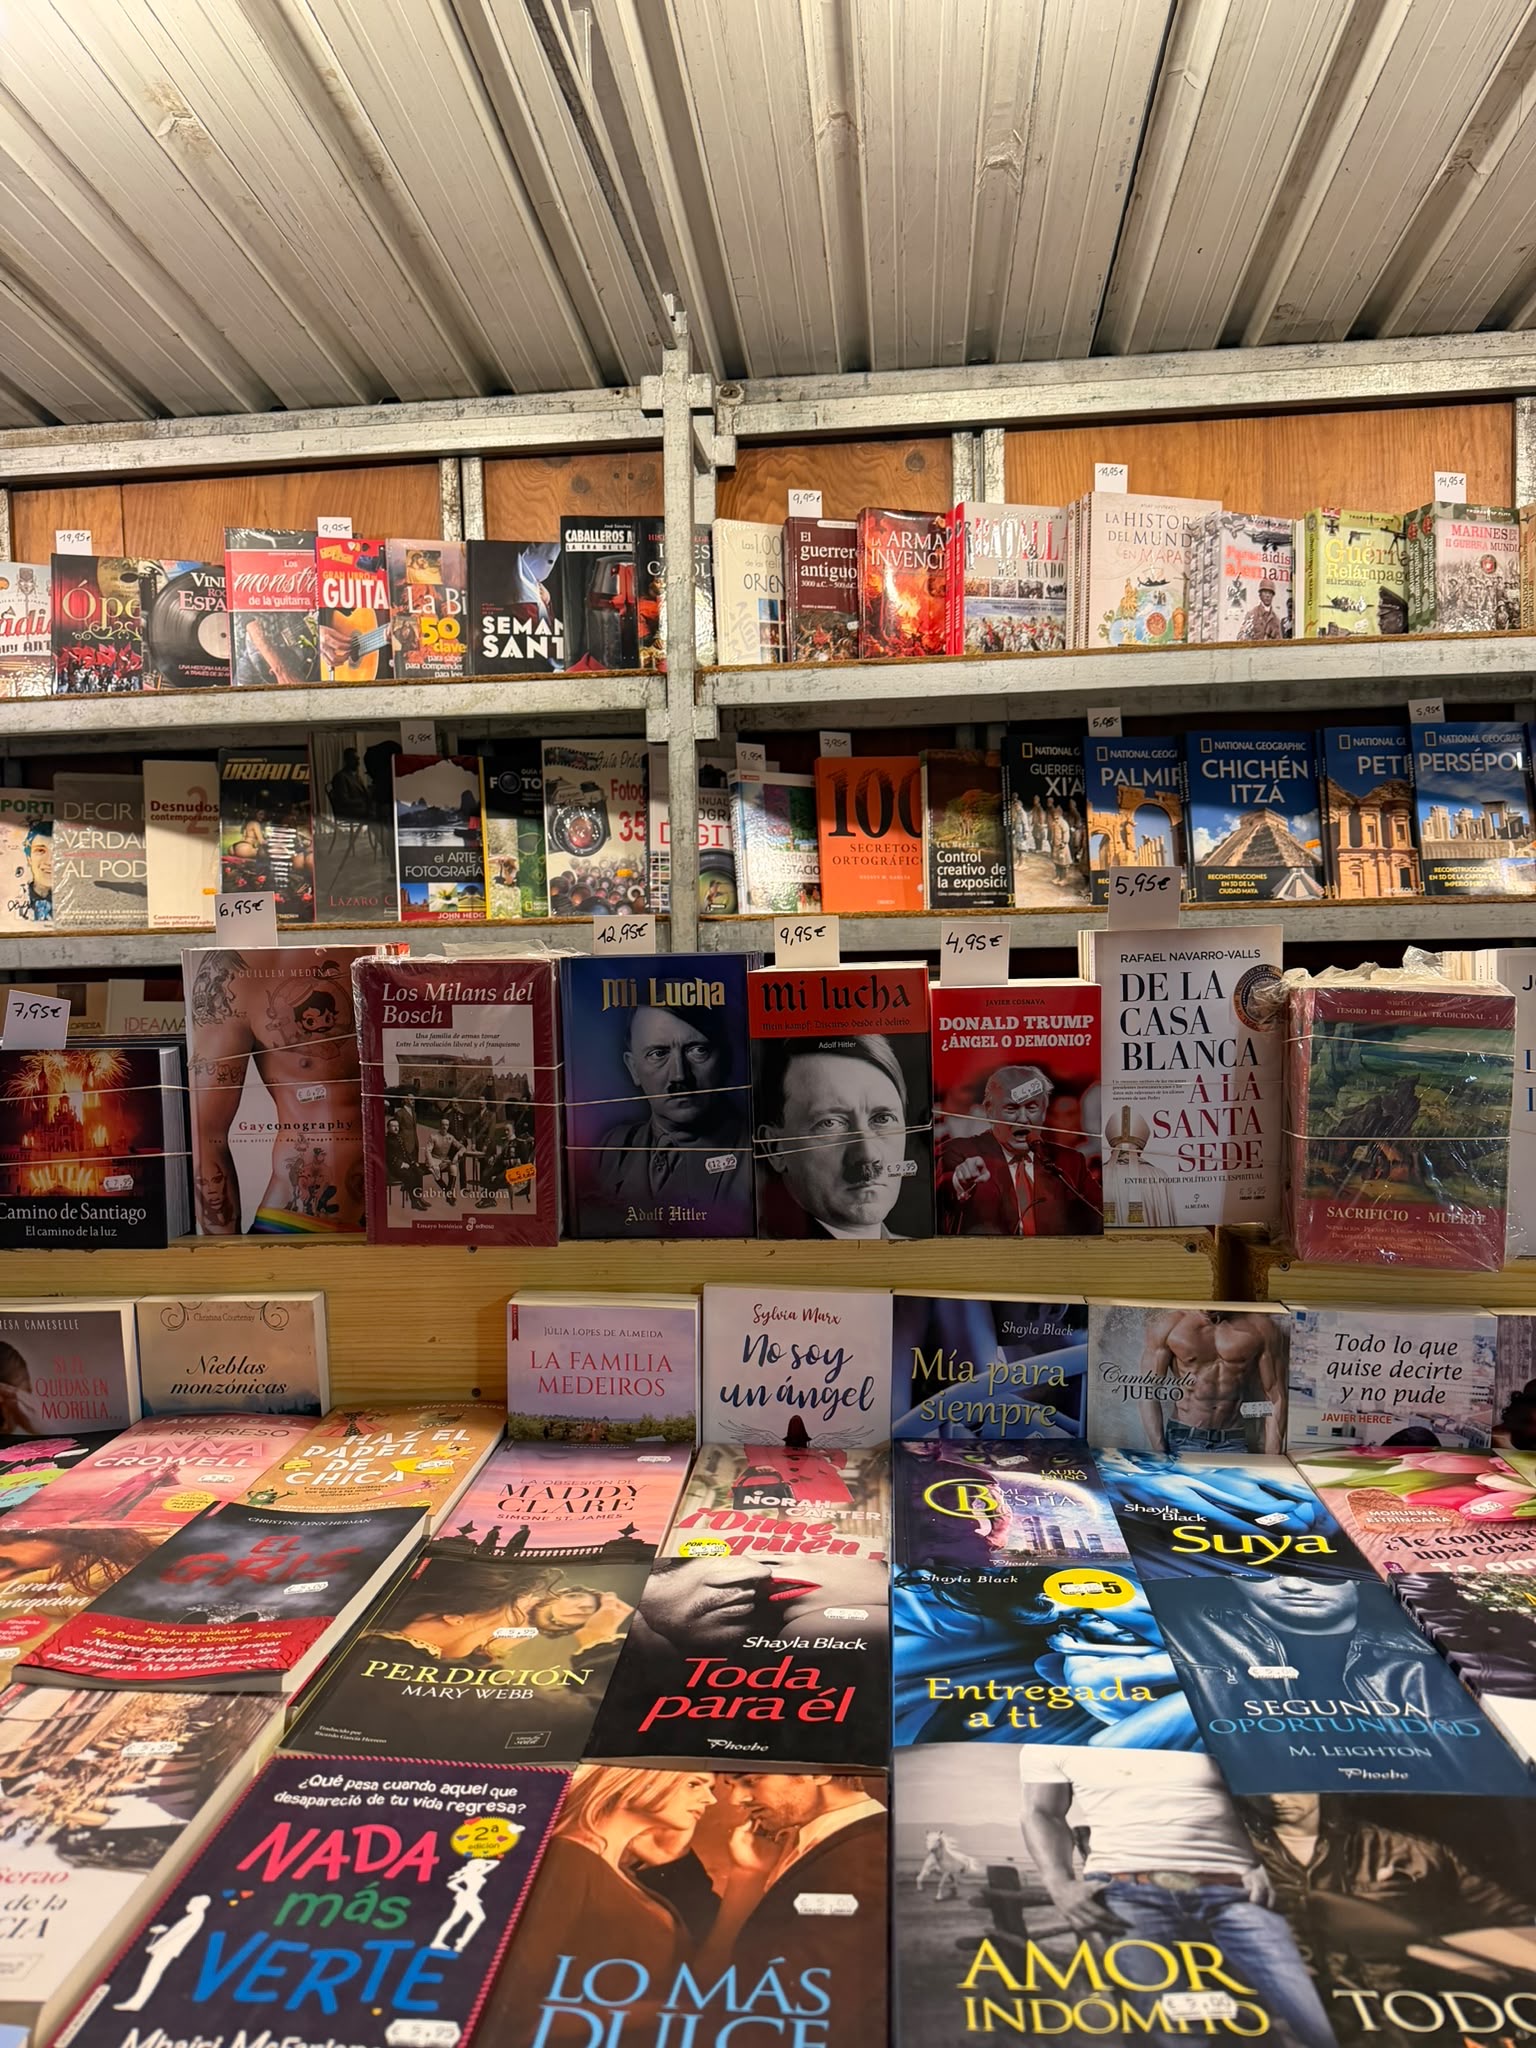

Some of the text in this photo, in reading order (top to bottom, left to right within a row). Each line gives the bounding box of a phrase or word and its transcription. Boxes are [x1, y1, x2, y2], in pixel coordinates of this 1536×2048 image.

[793, 494, 821, 504] 9,95€
[322, 523, 350, 532] 9,95€
[565, 530, 624, 542] CABALLEROS
[1452, 524, 1508, 539] MARINES
[801, 533, 811, 542] El
[872, 532, 945, 550] LA ARMA
[1123, 550, 1192, 564] EN MAPAS
[249, 596, 310, 606] de la guitarra
[323, 579, 388, 608] GUITA
[407, 588, 434, 614] La
[446, 589, 467, 615] Bi
[420, 618, 460, 646] 50
[1215, 742, 1306, 751] NATIONAL GEOGRAPHIC
[1202, 755, 1309, 779] CHICHÉN
[1231, 780, 1285, 803] ITZÁ
[64, 802, 133, 820] DECIR
[151, 801, 219, 813] Desnudos
[850, 843, 917, 853] SECRETOS
[937, 851, 982, 863] Control
[405, 865, 484, 877] FOTOGRAFÍA
[937, 862, 1006, 876] creativo de
[1115, 873, 1170, 897] 5,95€
[219, 900, 264, 917] 6,95€
[597, 922, 649, 945] 12,95€
[779, 925, 827, 946] 9,95€
[945, 931, 1003, 954] 4,95€
[1121, 949, 1260, 963] RAFAEL NAVARRO-VALLS
[239, 969, 331, 978] GUILLEM MEDINA
[383, 982, 534, 1001] Los Milans del
[1120, 970, 1226, 1002] DE LA
[13, 1002, 62, 1020] 7,95€
[382, 1005, 443, 1024] Bosch
[1431, 1011, 1485, 1020] TRADICIONAL
[939, 1015, 1094, 1031] DONALD TRUMP
[1120, 1005, 1212, 1037] CASA
[429, 1032, 451, 1040] familia
[818, 1040, 856, 1049] Adolf Hitler
[941, 1034, 1092, 1051] ¿ÁNGEL O DEMONIO?
[1121, 1038, 1261, 1071] BLANCA
[1188, 1074, 1211, 1103] A
[1221, 1072, 1264, 1102] LA
[239, 1121, 352, 1132] Gayconography
[1153, 1106, 1264, 1139] SANTA
[1179, 1140, 1263, 1172] SEDE
[412, 1188, 509, 1199] Gabriel Cardona
[25, 1226, 117, 1236] El camino de la luz
[24, 1319, 80, 1331] CAMESELLE
[1002, 1321, 1073, 1338] Shayla Black
[1334, 1333, 1458, 1358] Todo lo que
[186, 1355, 269, 1376] Nieblas
[530, 1350, 674, 1374] LA FAMILIA
[742, 1333, 853, 1384] No soy
[911, 1347, 1069, 1396] Mía para
[1326, 1360, 1463, 1381] quise decirte
[36, 1378, 108, 1398] QUEDAS EN
[170, 1379, 289, 1396] monzónicas
[537, 1375, 666, 1398] MEDEIROS
[719, 1375, 876, 1421] un ángel
[1340, 1386, 1446, 1407] y no pude
[920, 1392, 1057, 1437] siempre
[1321, 1413, 1392, 1425] JAVIER HERCE
[343, 1429, 471, 1446] HAZ EL
[112, 1440, 264, 1457] ANNA
[302, 1443, 419, 1458] PAPEL
[94, 1456, 251, 1468] CROWELL
[323, 1458, 375, 1472] DE
[285, 1470, 406, 1486] CHICA
[498, 1482, 650, 1500] MADDY
[497, 1498, 637, 1515] CLARE
[743, 1495, 832, 1510] NORAH
[785, 1506, 883, 1522] CARTER
[1171, 1525, 1338, 1565] Suya
[160, 1546, 363, 1587] GRIS
[742, 1635, 868, 1651] Shayla Black
[361, 1660, 594, 1687] PERDICIÓN
[683, 1656, 821, 1690] Toda
[401, 1685, 534, 1700] MARY WEBB
[924, 1677, 1159, 1703] Entregada
[637, 1685, 857, 1733] para él
[1243, 1699, 1430, 1718] SEGUNDA
[1208, 1716, 1482, 1738] OPORTUNIDAD
[298, 1774, 518, 1798] ¿Qué pasa cuando aquel que
[273, 1791, 526, 1816] desapareció de tu vida regresa?
[235, 1821, 440, 1884] NADA
[271, 1881, 412, 1931] más
[190, 1930, 459, 2015] VERTE
[956, 1938, 1260, 1997] AMOR
[545, 1954, 832, 2018] LO MÁS
